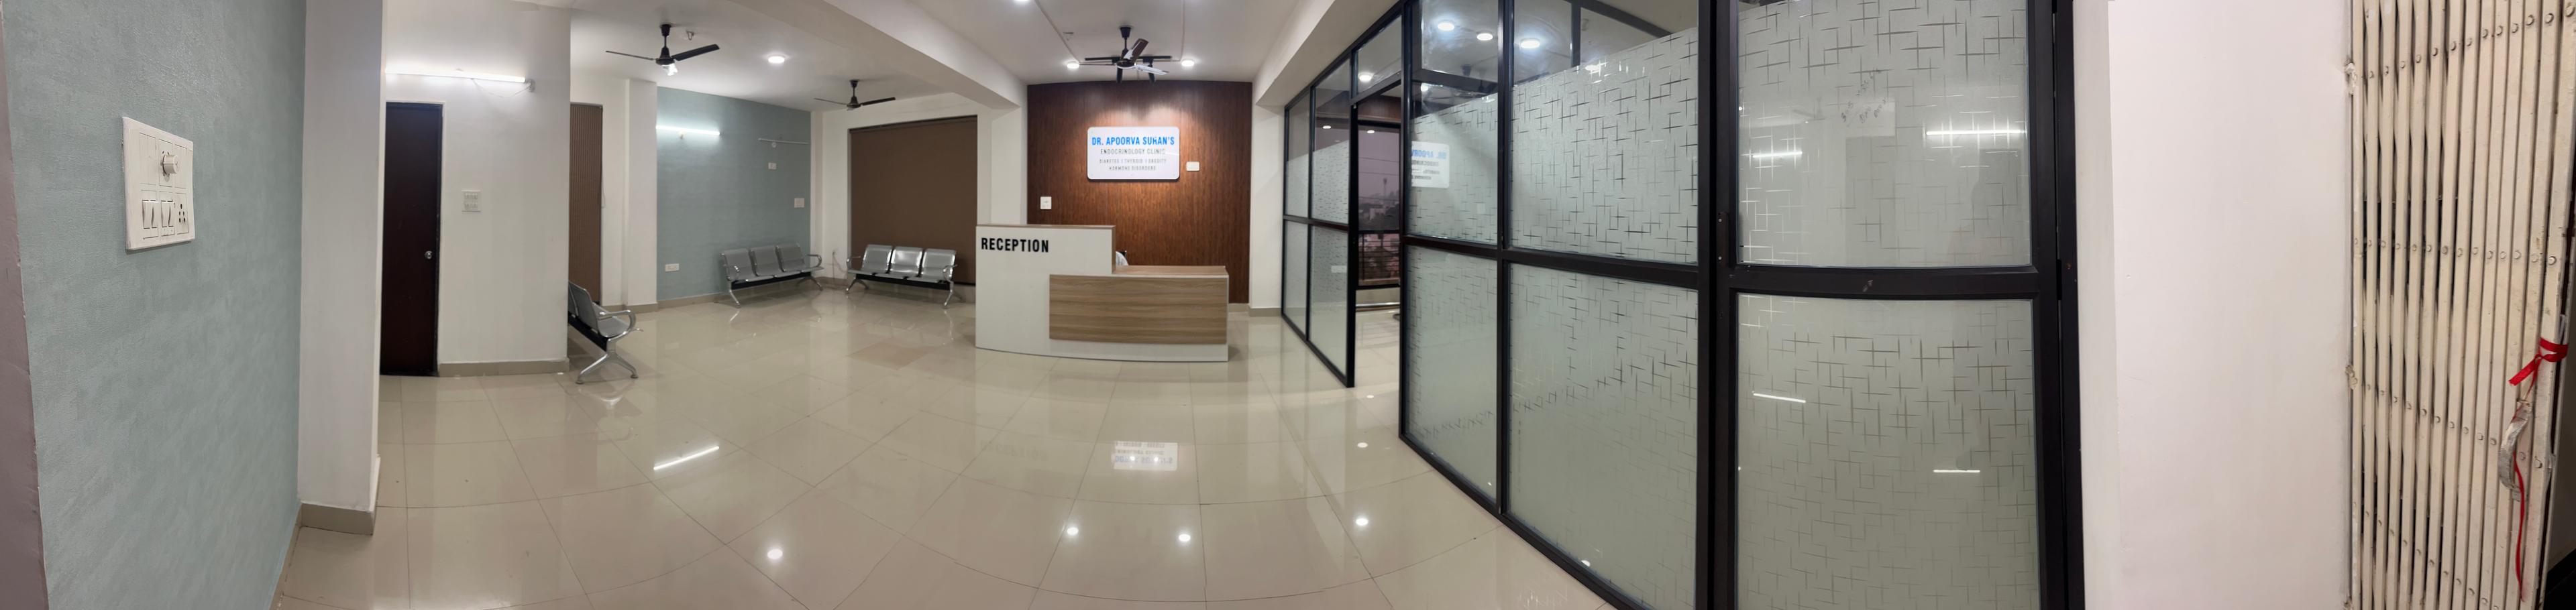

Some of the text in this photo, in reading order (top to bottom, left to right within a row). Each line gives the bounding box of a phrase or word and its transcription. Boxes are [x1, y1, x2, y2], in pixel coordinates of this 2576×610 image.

[1091, 137, 1175, 145] DR. APOORVA SUHAN'S
[981, 237, 1049, 253] RECEPTION
